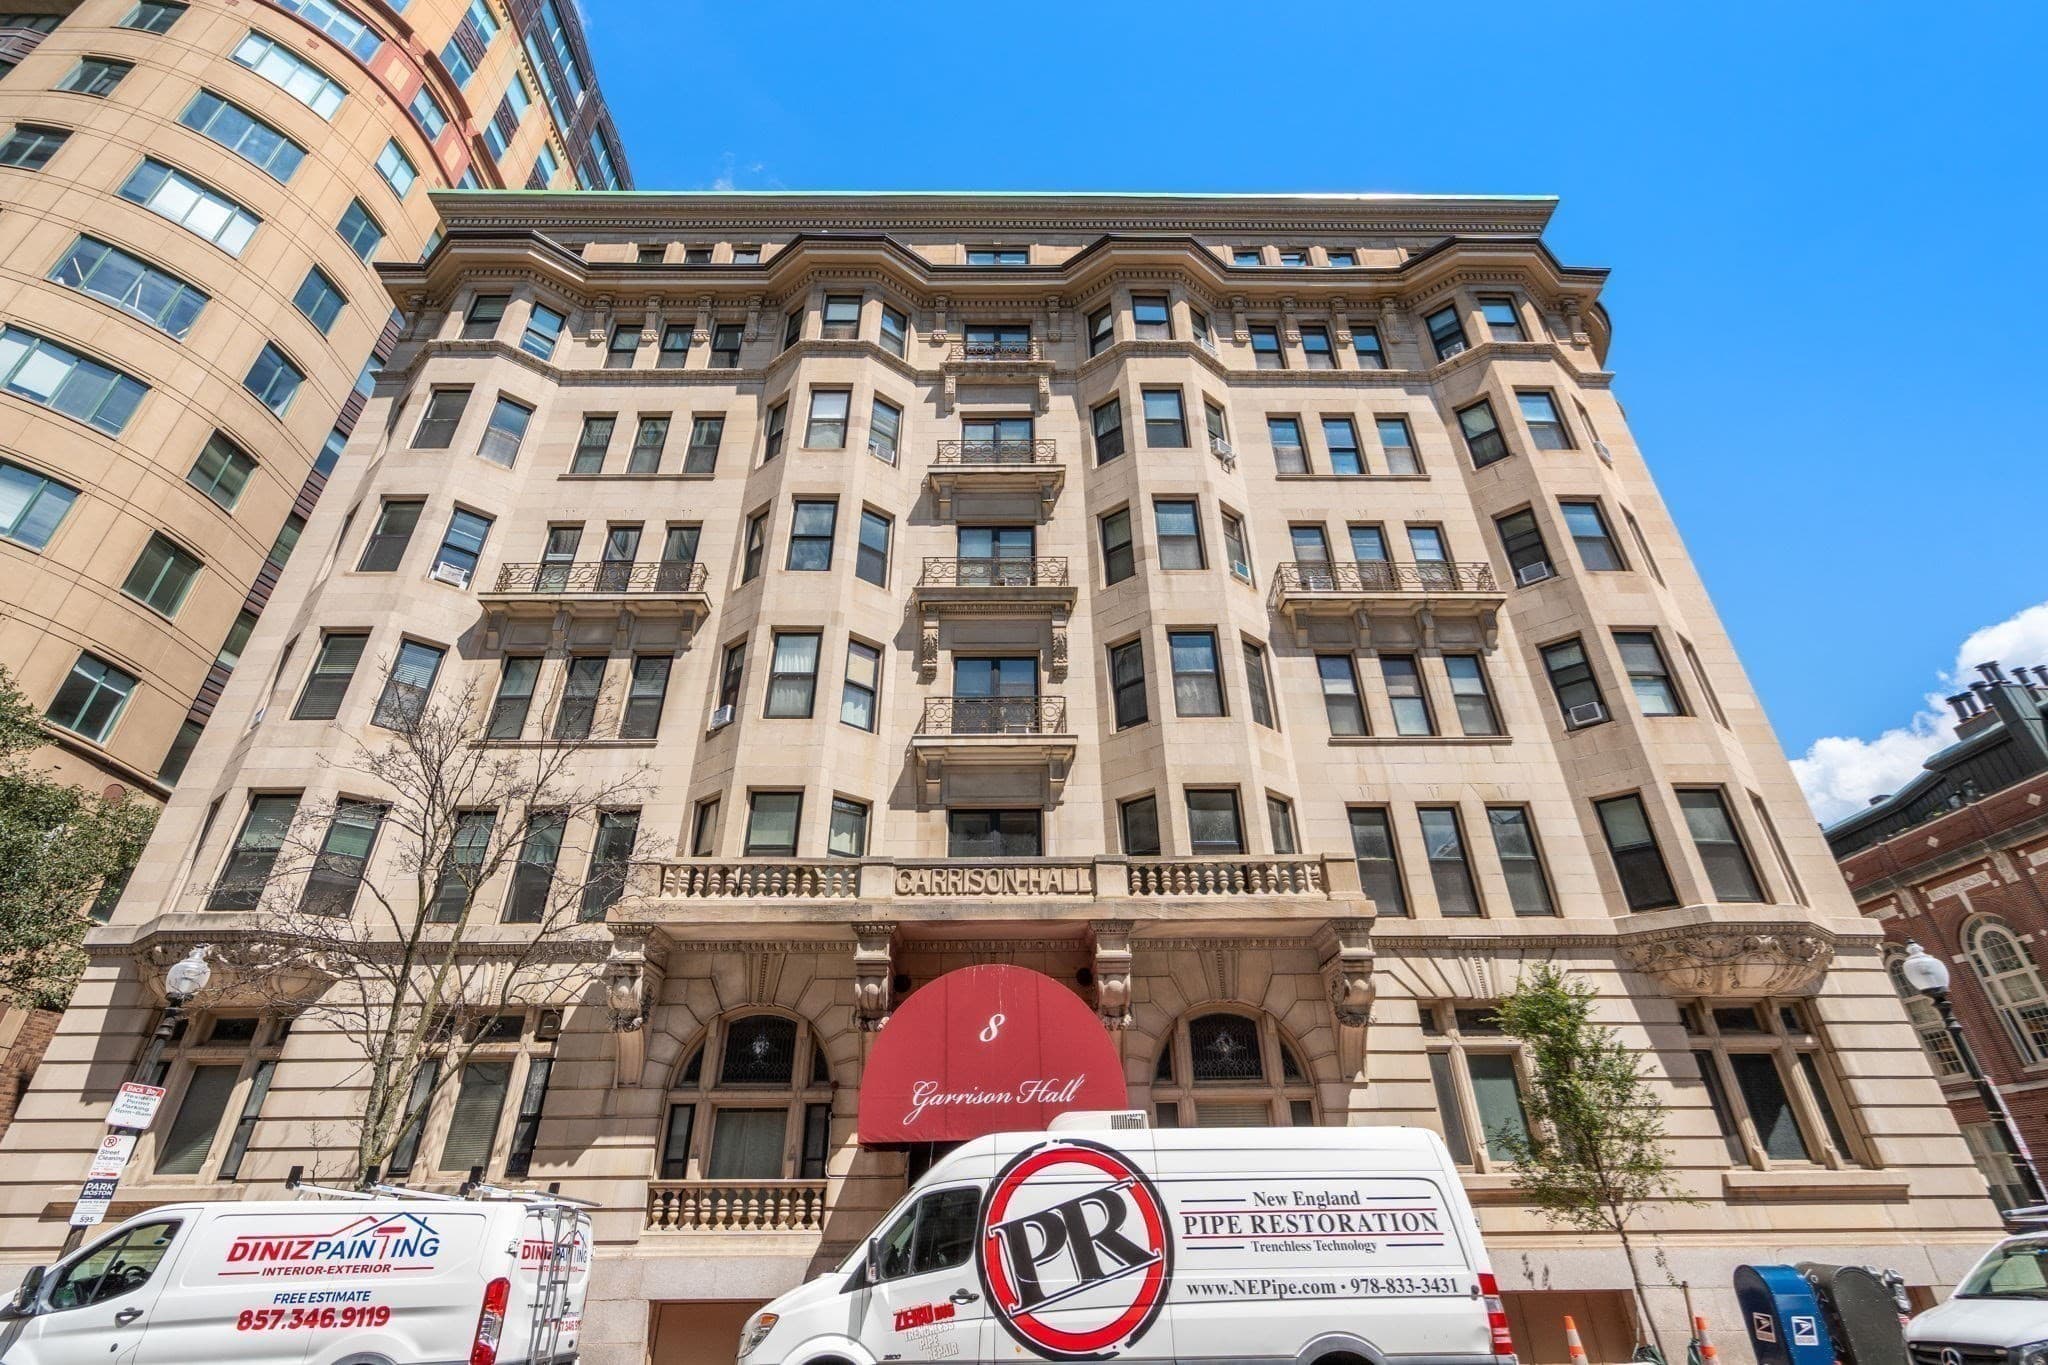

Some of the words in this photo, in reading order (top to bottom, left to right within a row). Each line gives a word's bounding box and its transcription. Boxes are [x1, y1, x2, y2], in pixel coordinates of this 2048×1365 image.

[979, 1013, 1006, 1042] 8
[121, 1104, 150, 1113] Parking
[903, 1080, 1013, 1126] Garrison
[1016, 1073, 1086, 1104] Hall
[97, 1155, 125, 1163] Cleaning
[85, 1182, 115, 1191] PARK
[1253, 1191, 1288, 1207] New
[1294, 1190, 1361, 1210] England
[1184, 1215, 1243, 1236] PIPE
[1250, 1211, 1440, 1235] RESTORATION
[988, 1178, 1162, 1315] PR
[1250, 1240, 1312, 1253] Trenchless
[1313, 1239, 1378, 1254] Technology
[262, 1264, 391, 1277] INTERIOR-EXTERIOR
[273, 1293, 307, 1305] FREE
[308, 1290, 371, 1304] ESTIMATE
[1186, 1278, 1337, 1300] www.NEPipe.com
[1349, 1277, 1459, 1295] 978-833-3431
[236, 1305, 391, 1332] 857.346.9119
[893, 1303, 934, 1332] ZERO
[919, 1334, 940, 1351] PIPE
[927, 1343, 960, 1361] REPAIR
